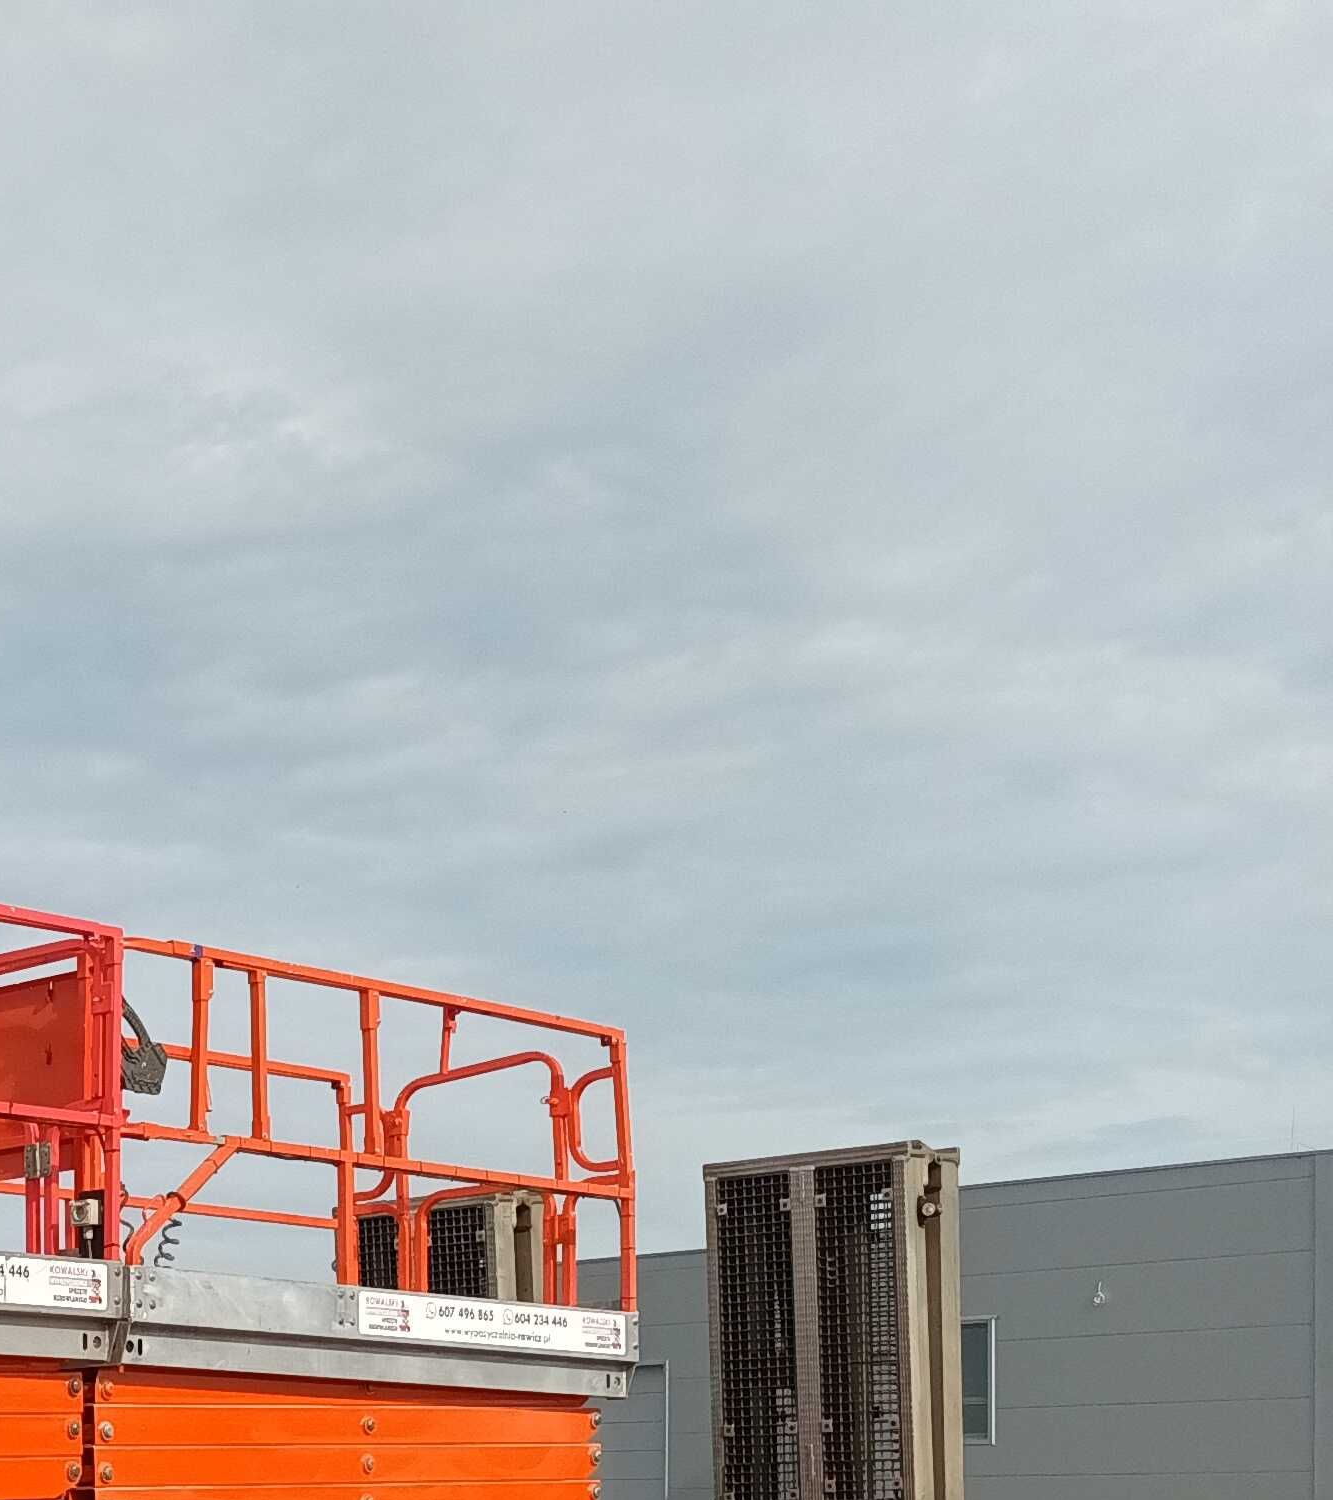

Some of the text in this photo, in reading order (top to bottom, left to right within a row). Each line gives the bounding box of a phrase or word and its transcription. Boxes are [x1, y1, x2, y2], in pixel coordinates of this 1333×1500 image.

[9, 1264, 30, 1279] 446
[438, 1306, 494, 1321] 607 496 865
[514, 1313, 568, 1328] 604 234 446
